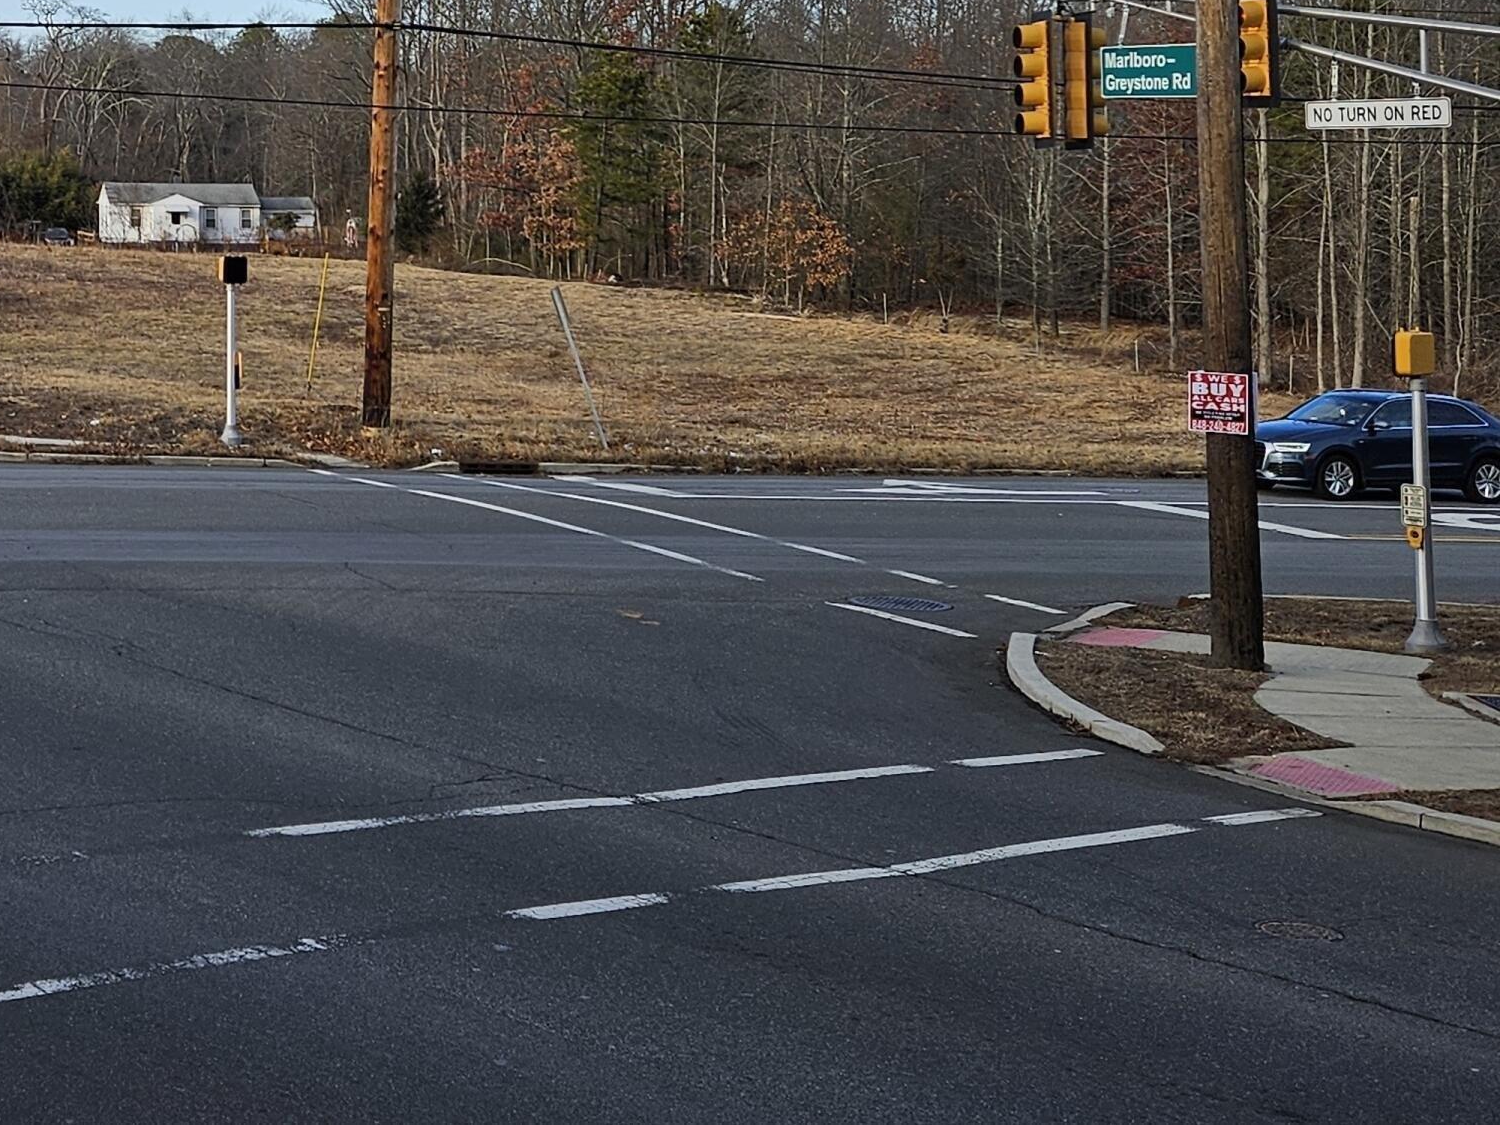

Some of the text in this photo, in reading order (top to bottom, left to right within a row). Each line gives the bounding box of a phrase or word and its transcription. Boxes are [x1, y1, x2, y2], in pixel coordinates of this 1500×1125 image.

[1104, 51, 1176, 68] Marlboro-
[1105, 73, 1191, 94] Greystone Rd
[1313, 104, 1442, 122] NO TURN ON RED
[1207, 375, 1229, 384] WE
[1191, 381, 1245, 397] BUY
[1191, 394, 1245, 404] ALL CARS
[1191, 401, 1245, 413] CASH
